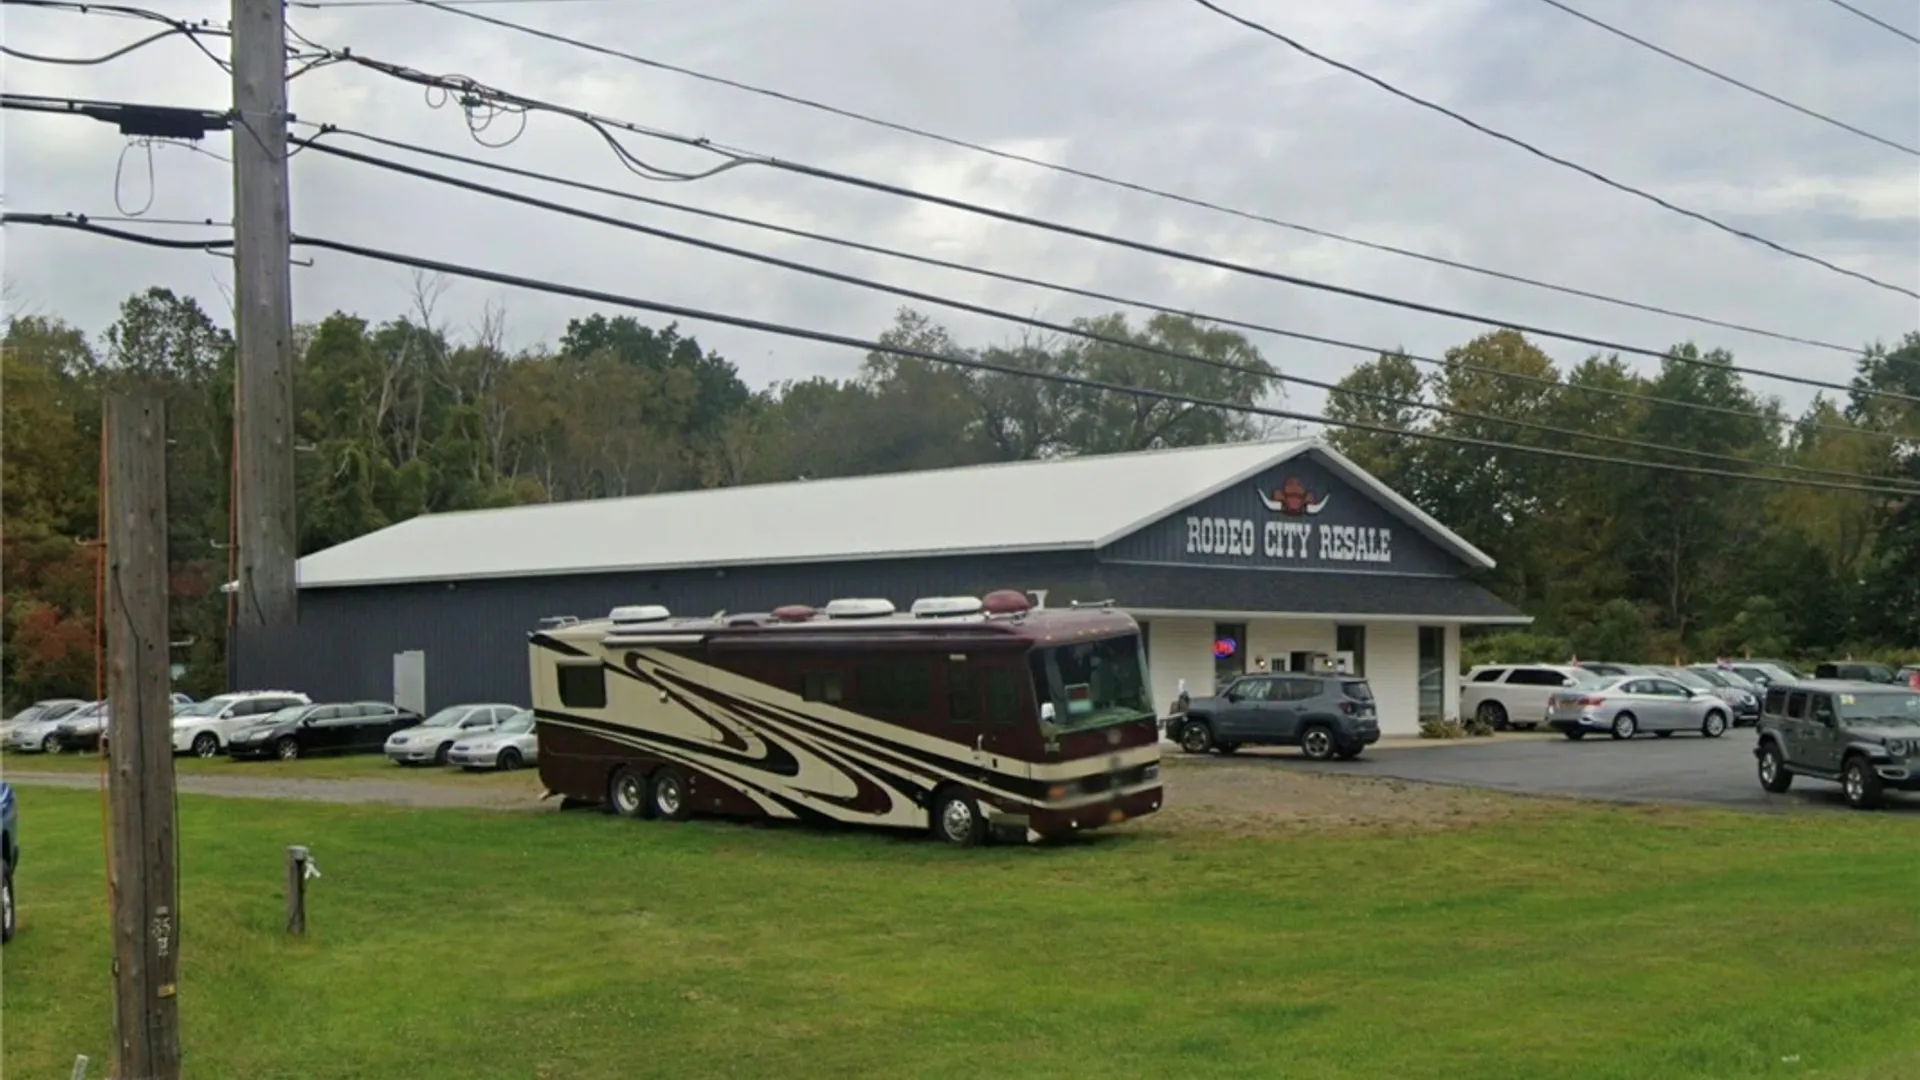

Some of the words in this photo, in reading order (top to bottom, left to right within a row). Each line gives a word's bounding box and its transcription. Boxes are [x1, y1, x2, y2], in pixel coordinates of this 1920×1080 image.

[1186, 516, 1254, 556] RODEO
[1264, 520, 1312, 559] CITY
[1319, 524, 1391, 562] RESALE
